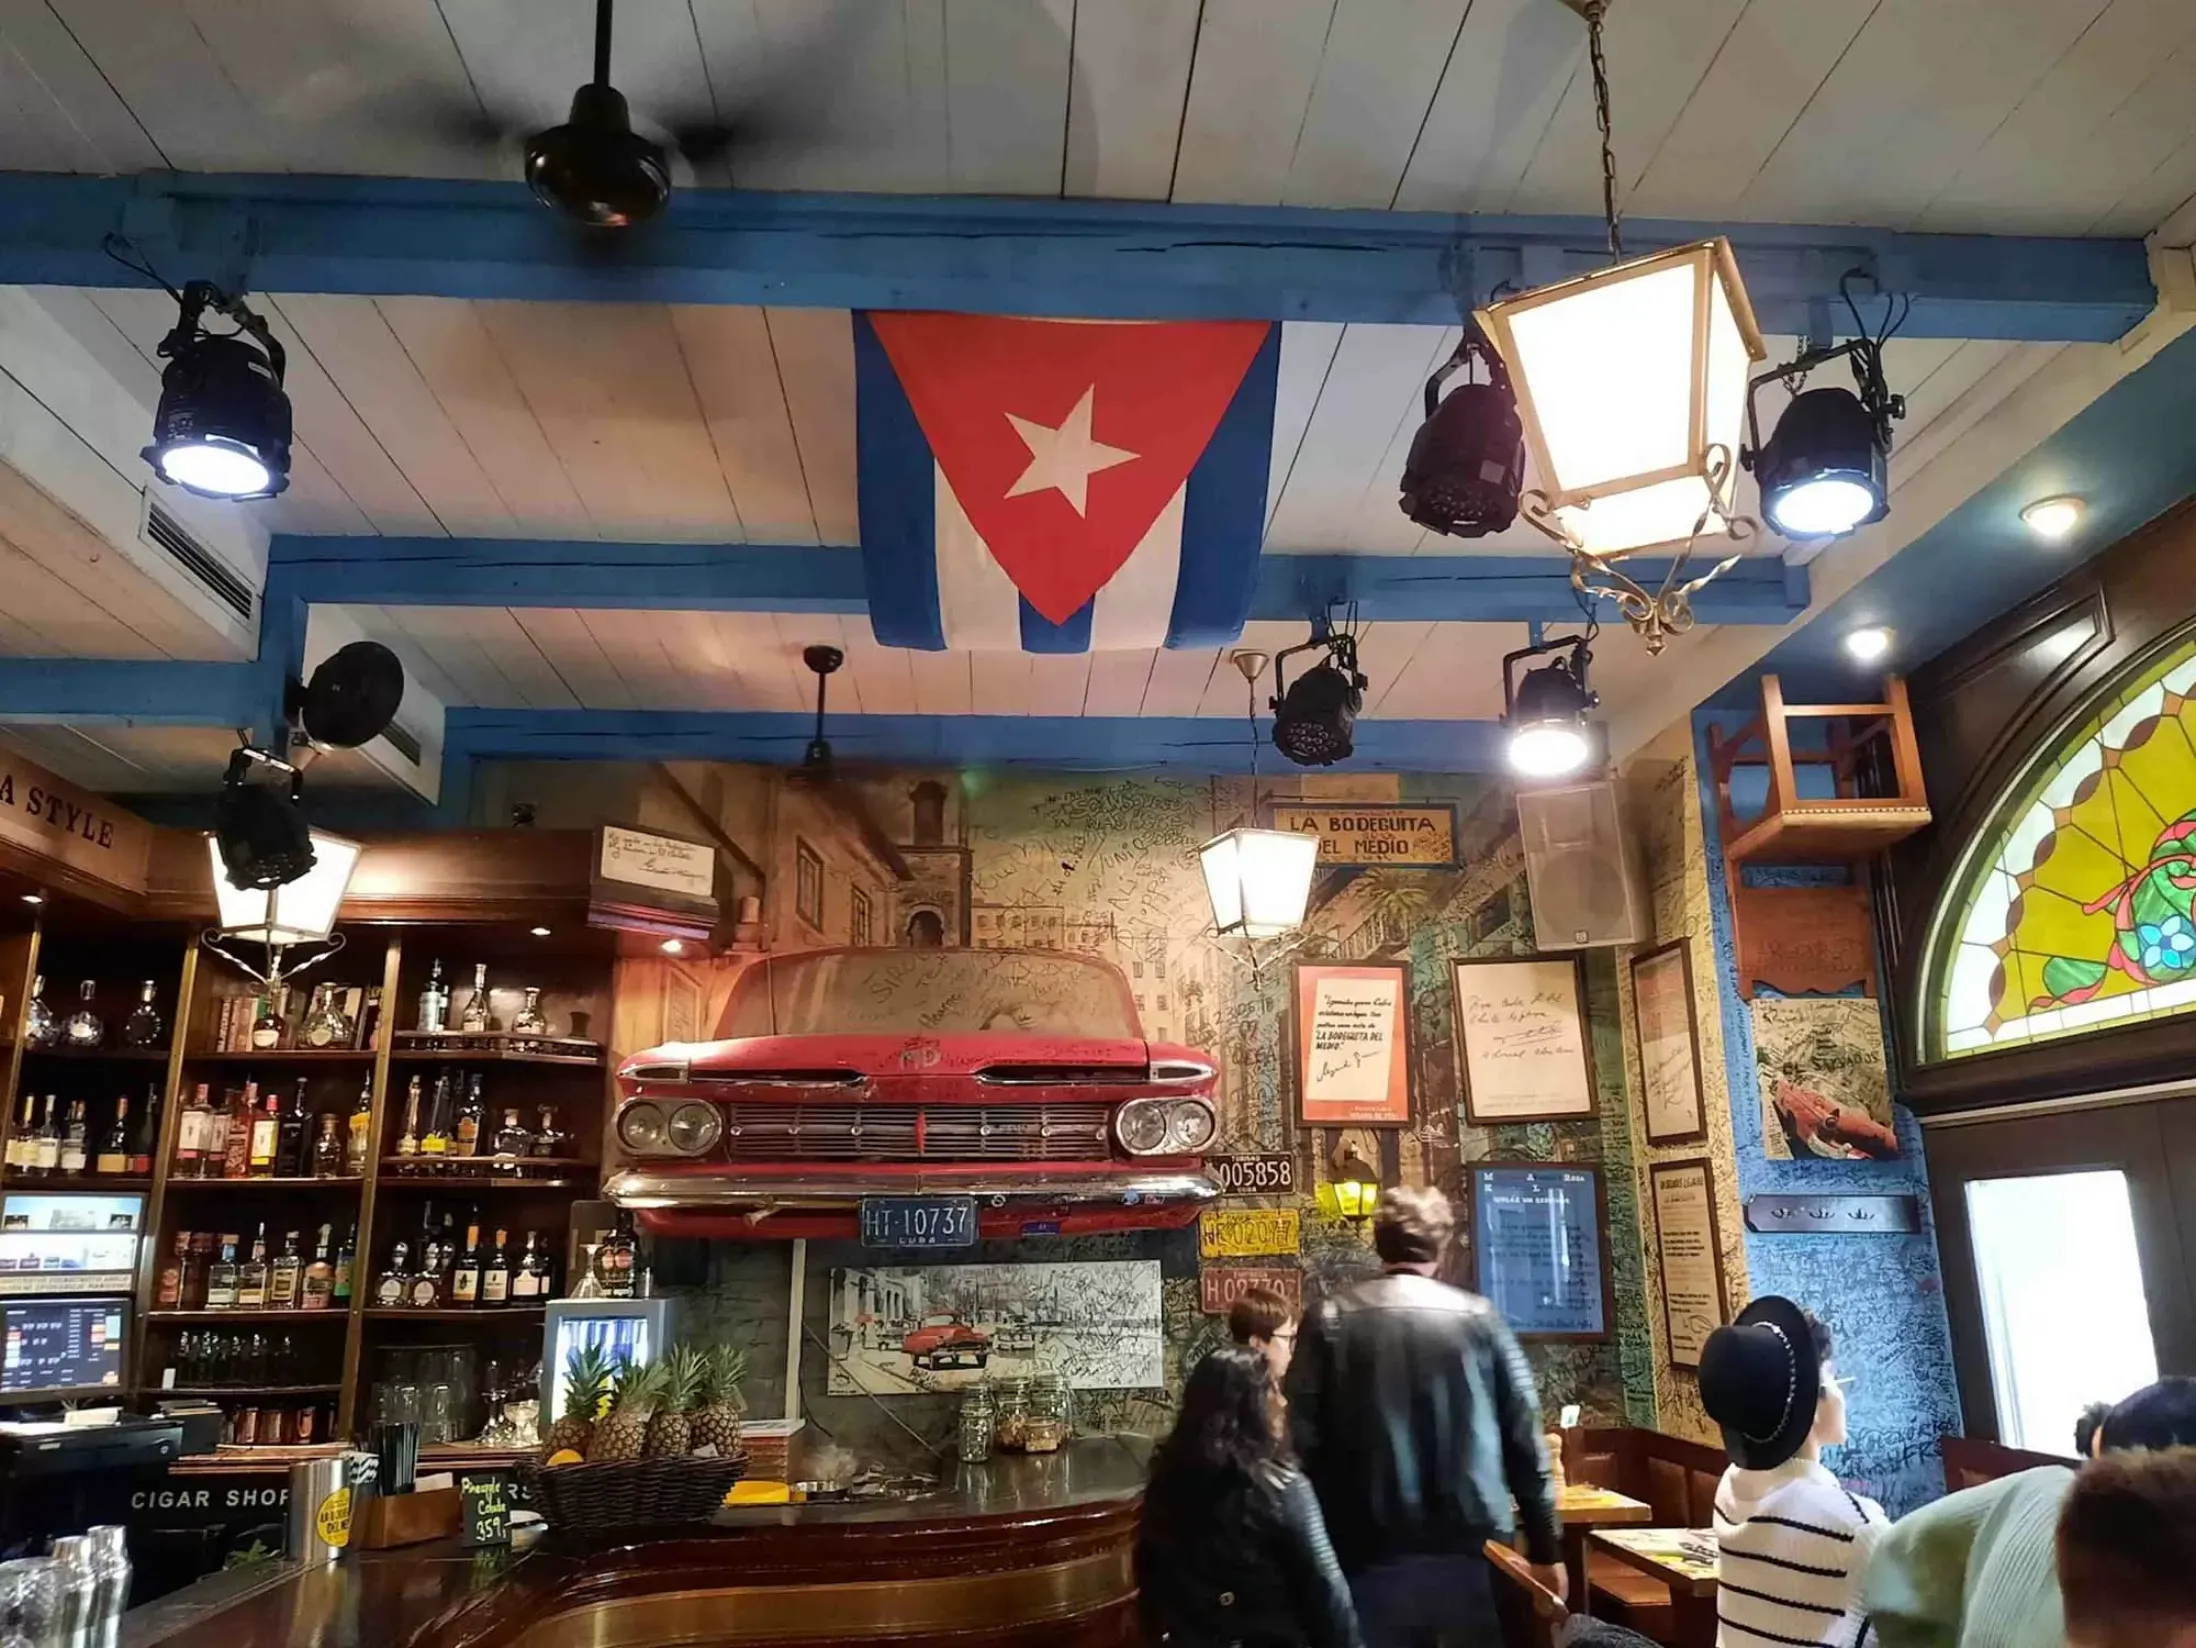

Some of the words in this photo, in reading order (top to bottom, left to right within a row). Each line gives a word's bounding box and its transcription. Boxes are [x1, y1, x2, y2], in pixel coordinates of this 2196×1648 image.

[26, 786, 114, 849] STYLE
[1290, 817, 1319, 832] LA
[1329, 817, 1436, 832] BODEGUITA
[1355, 840, 1409, 855] MEDIO
[865, 1206, 968, 1237] HT-10737
[131, 1490, 210, 1509] CIGAR
